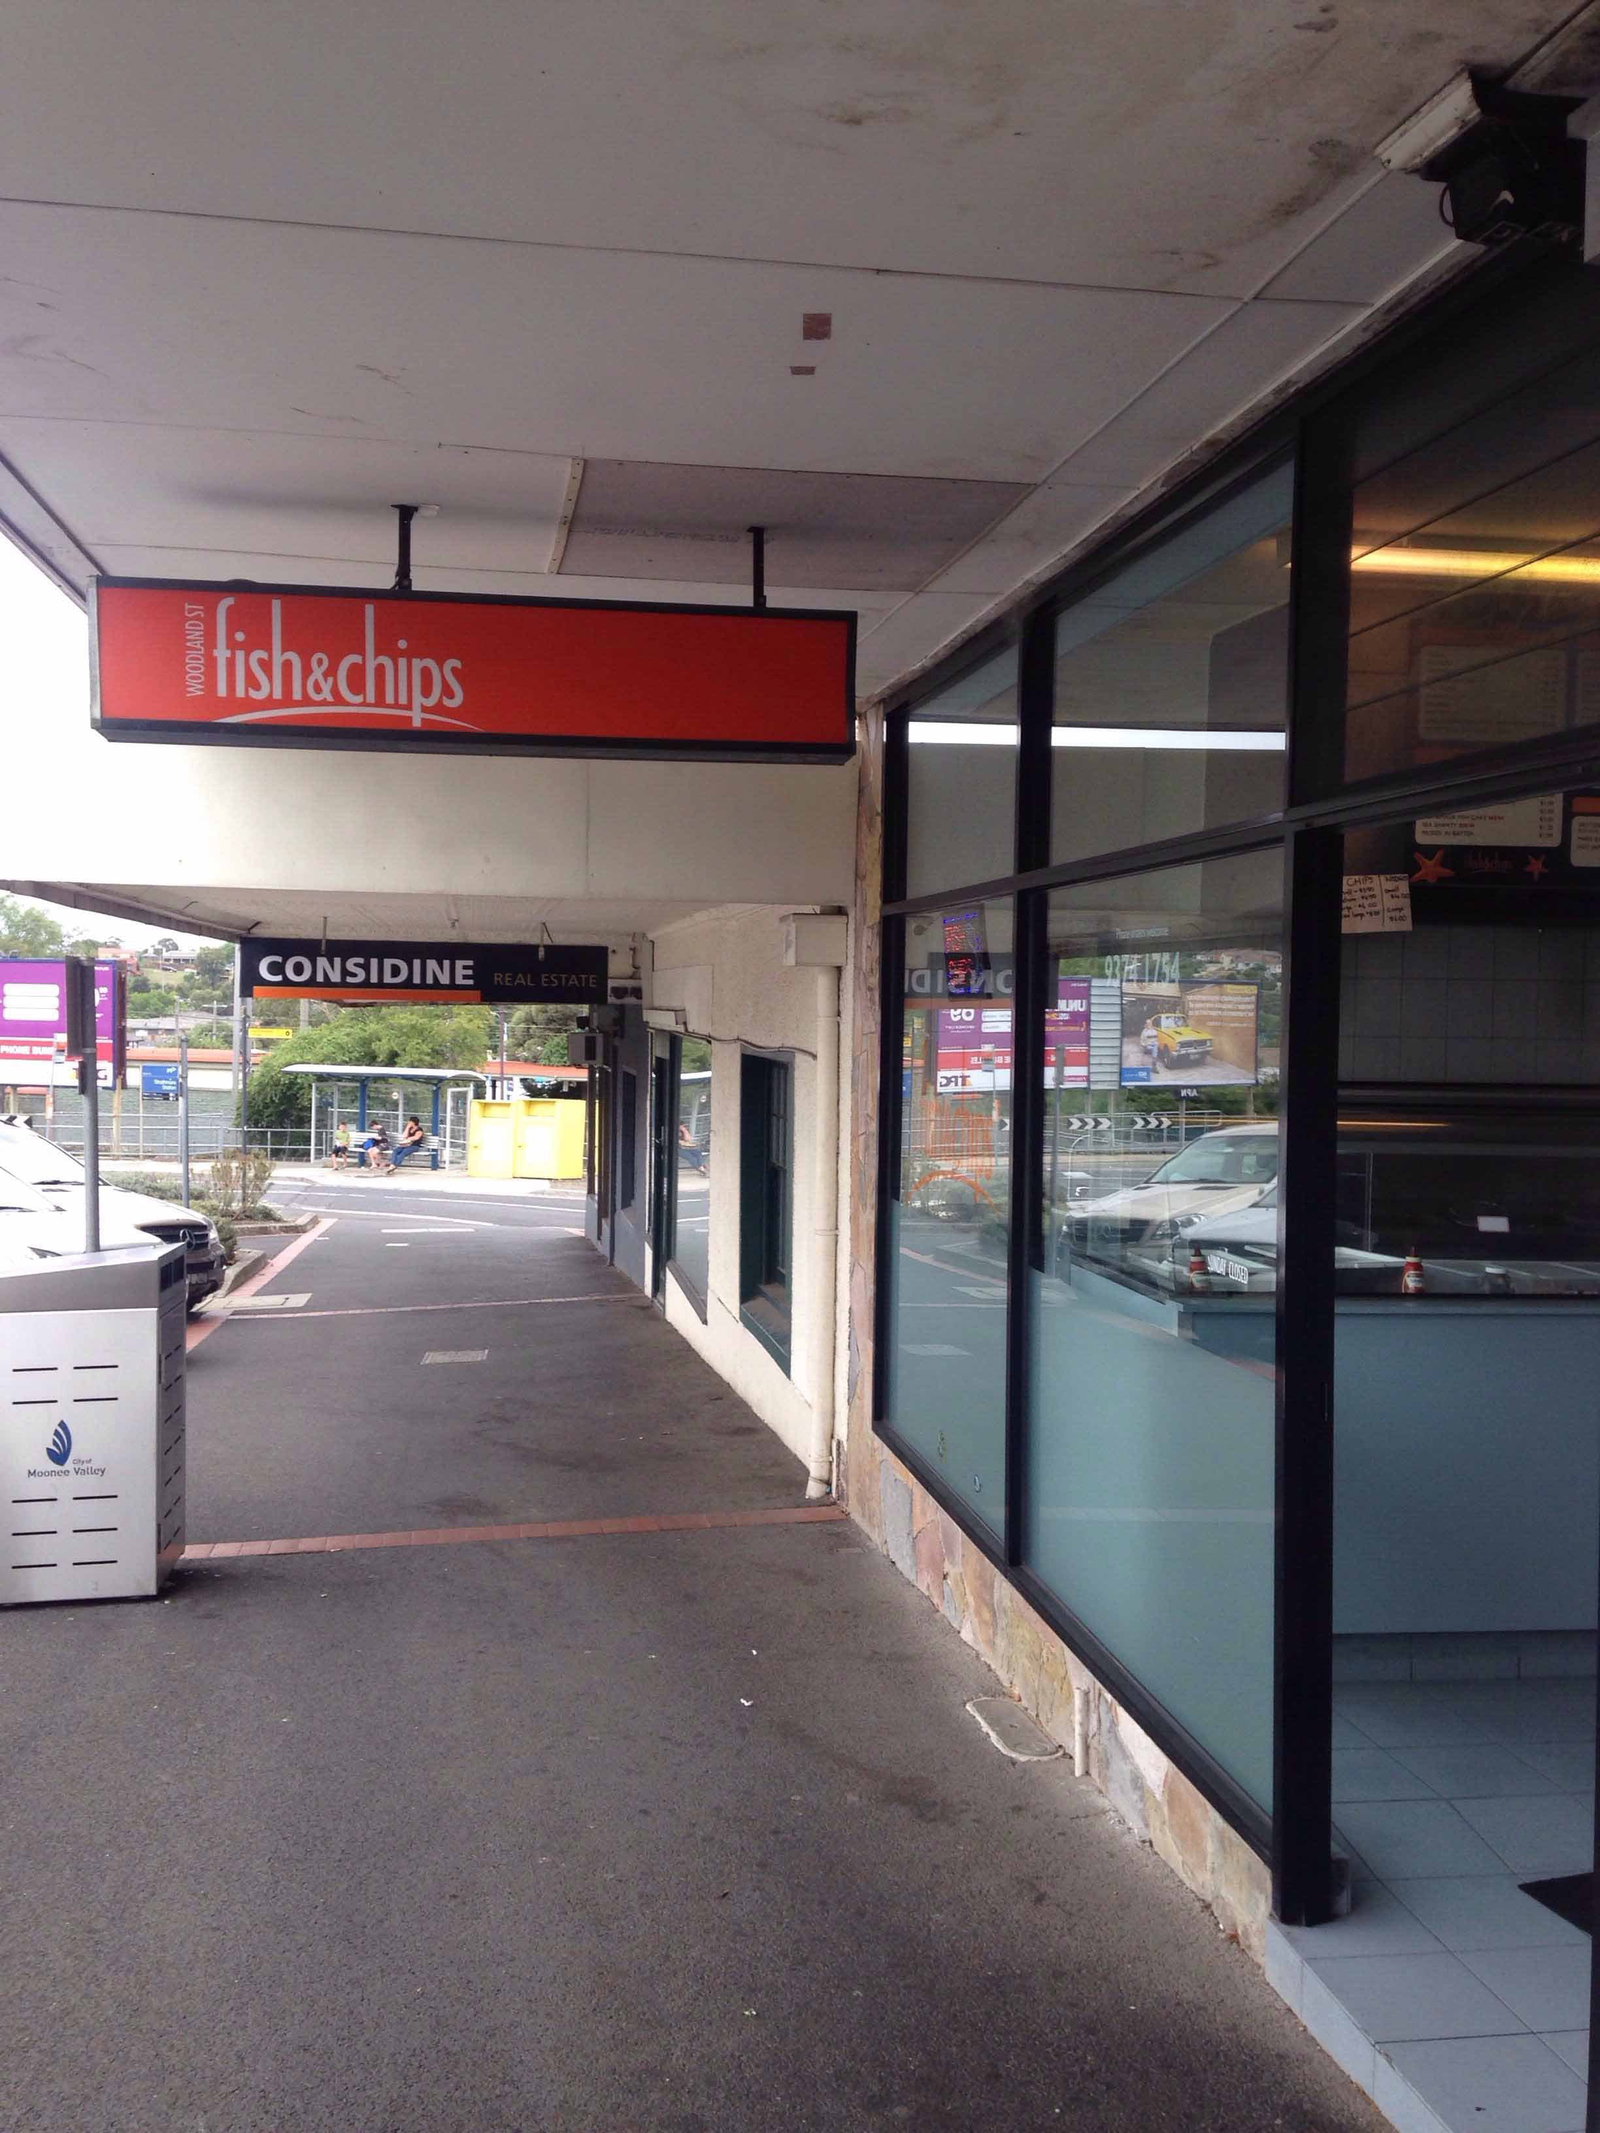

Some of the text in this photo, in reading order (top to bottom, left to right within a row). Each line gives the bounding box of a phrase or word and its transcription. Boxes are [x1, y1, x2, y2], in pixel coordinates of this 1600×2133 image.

[184, 602, 206, 697] WOODLAND ST
[213, 596, 464, 728] fish&chips
[258, 954, 599, 989] CONSIDINE REAL ESTATE
[1228, 1262, 1249, 1284] CLOSED
[27, 1466, 107, 1478] Moonee Valley
